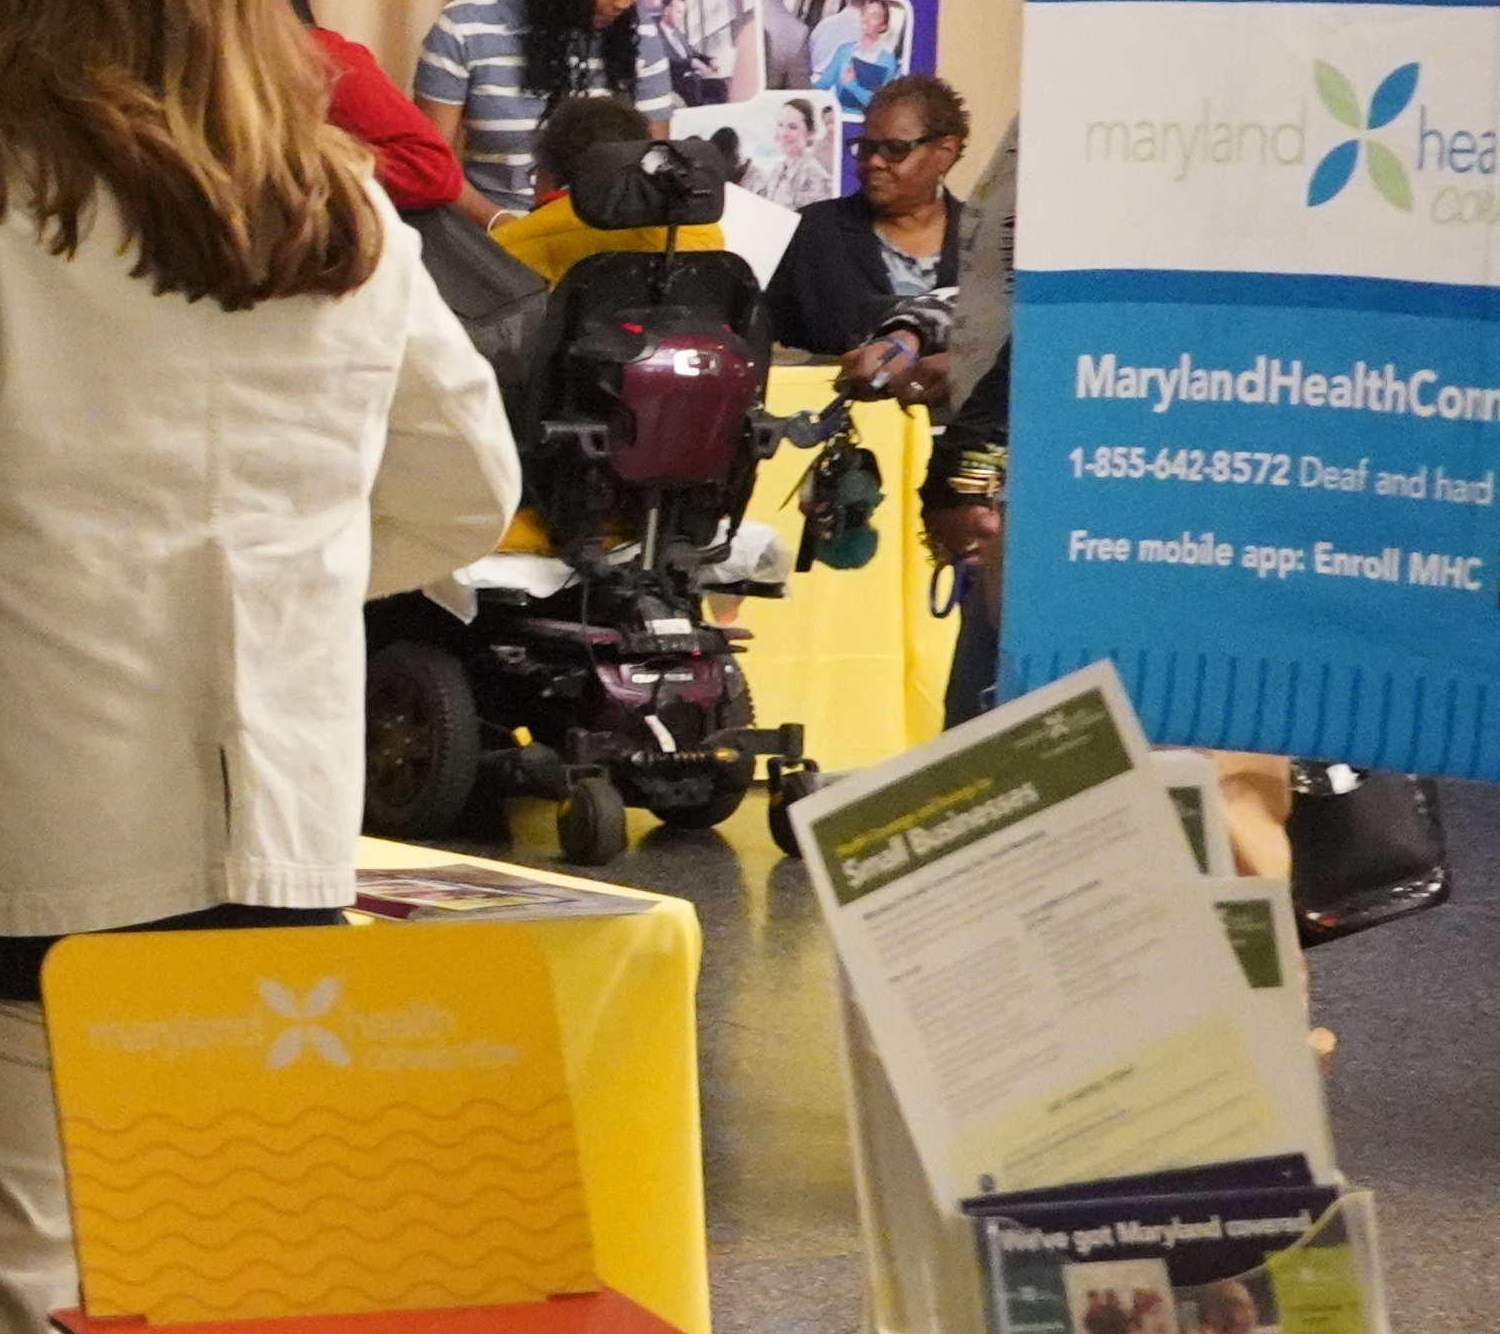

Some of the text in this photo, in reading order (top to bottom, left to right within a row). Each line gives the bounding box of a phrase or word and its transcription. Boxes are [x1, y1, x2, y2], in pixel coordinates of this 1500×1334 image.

[1084, 98, 1499, 183] maryland hea
[1076, 352, 1500, 423] MarylandHealthConn
[1069, 445, 1494, 507] 1-855-642-8572 Deaf and hard
[1068, 529, 1483, 591] Free mobile app: Enroll MHC
[1071, 1223, 1116, 1255] got
